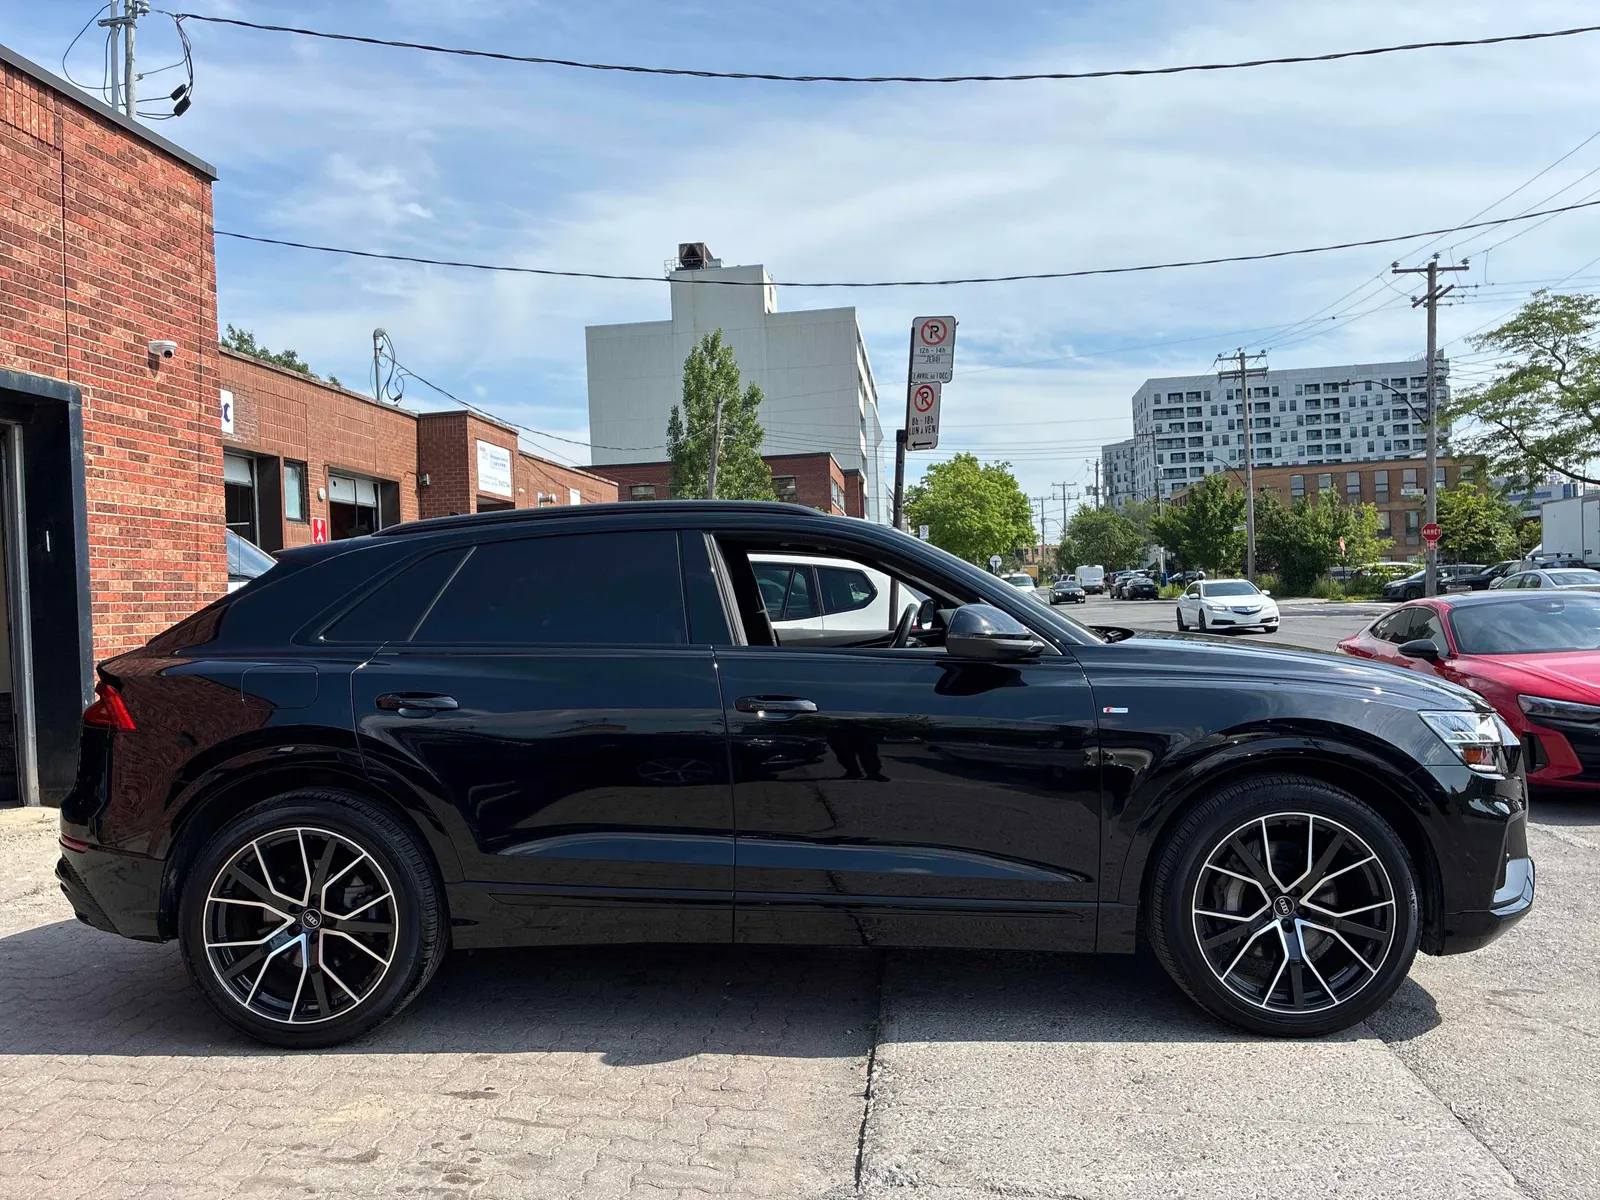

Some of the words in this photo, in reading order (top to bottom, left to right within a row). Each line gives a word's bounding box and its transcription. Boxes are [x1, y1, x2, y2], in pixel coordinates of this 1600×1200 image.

[912, 417, 919, 426] 8h
[924, 415, 934, 425] 18h
[908, 426, 920, 436] LUN
[924, 424, 937, 434] VEN
